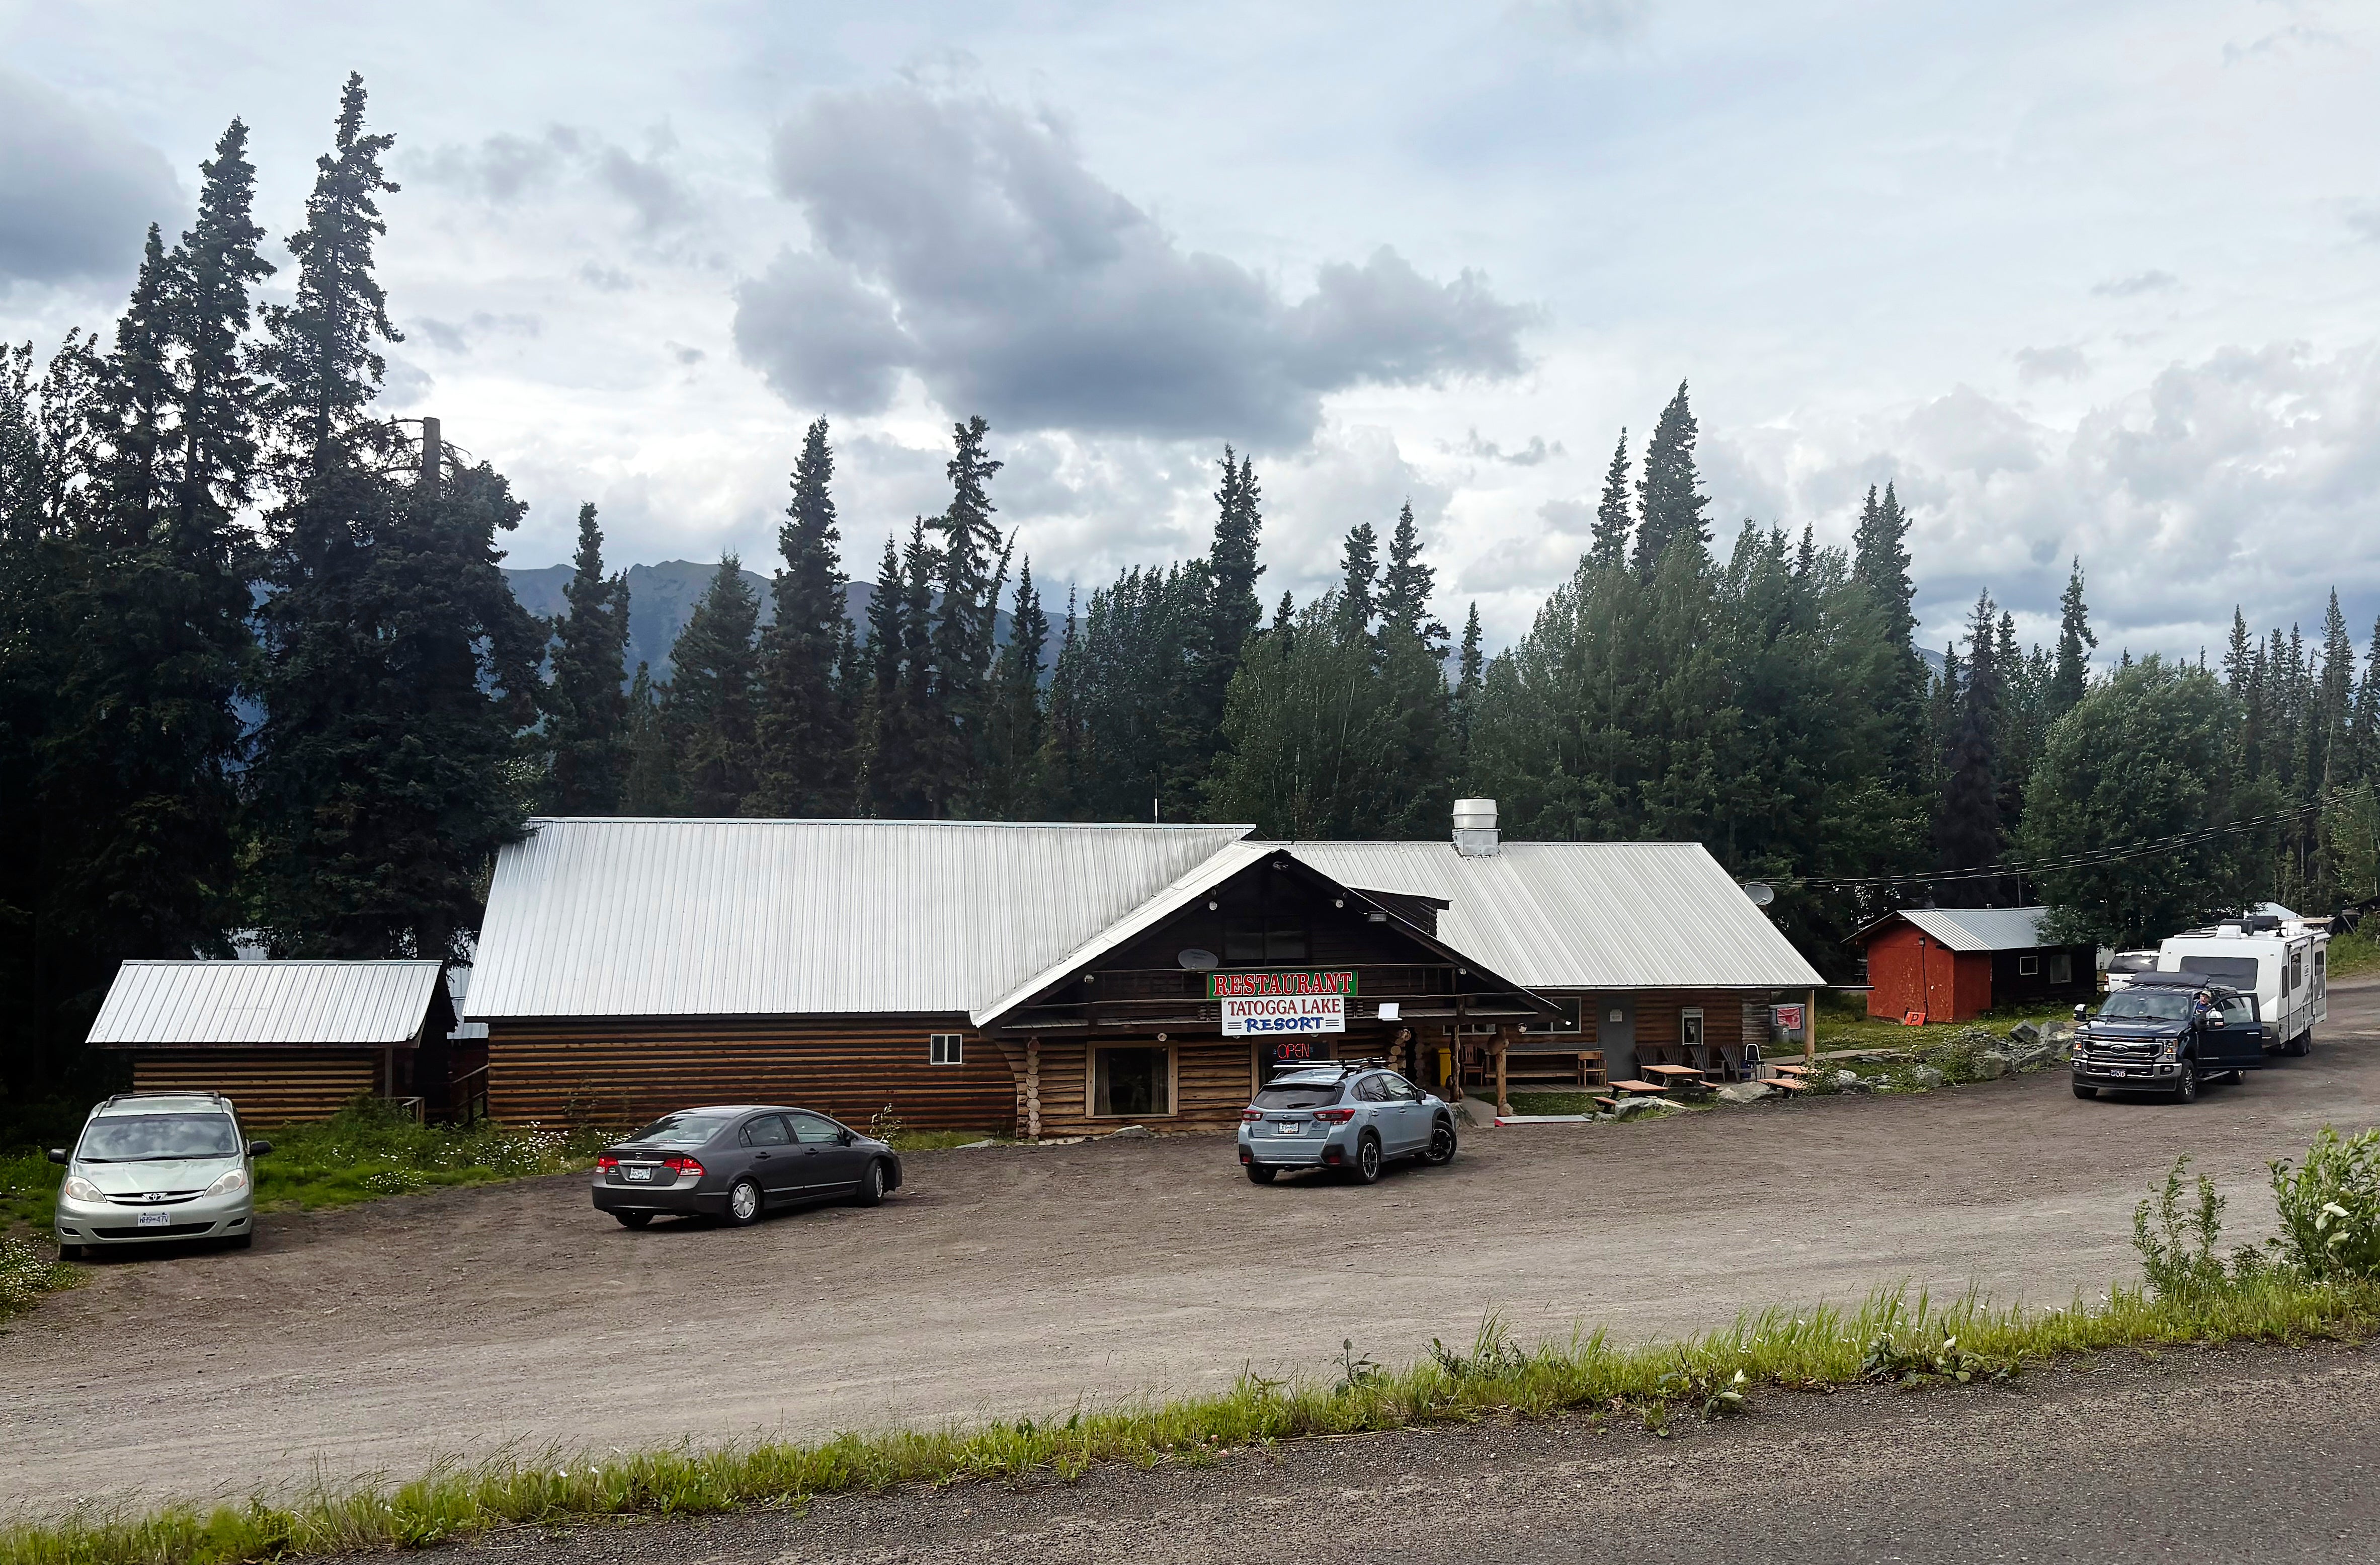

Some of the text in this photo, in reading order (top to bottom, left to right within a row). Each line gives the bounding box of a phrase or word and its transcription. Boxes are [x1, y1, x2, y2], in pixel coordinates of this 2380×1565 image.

[1213, 972, 1352, 996] RESTAURANT
[1228, 998, 1342, 1016] TATOGGA LAKE
[1244, 1016, 1325, 1033] RESORT
[1277, 1043, 1309, 1059] OPEN
